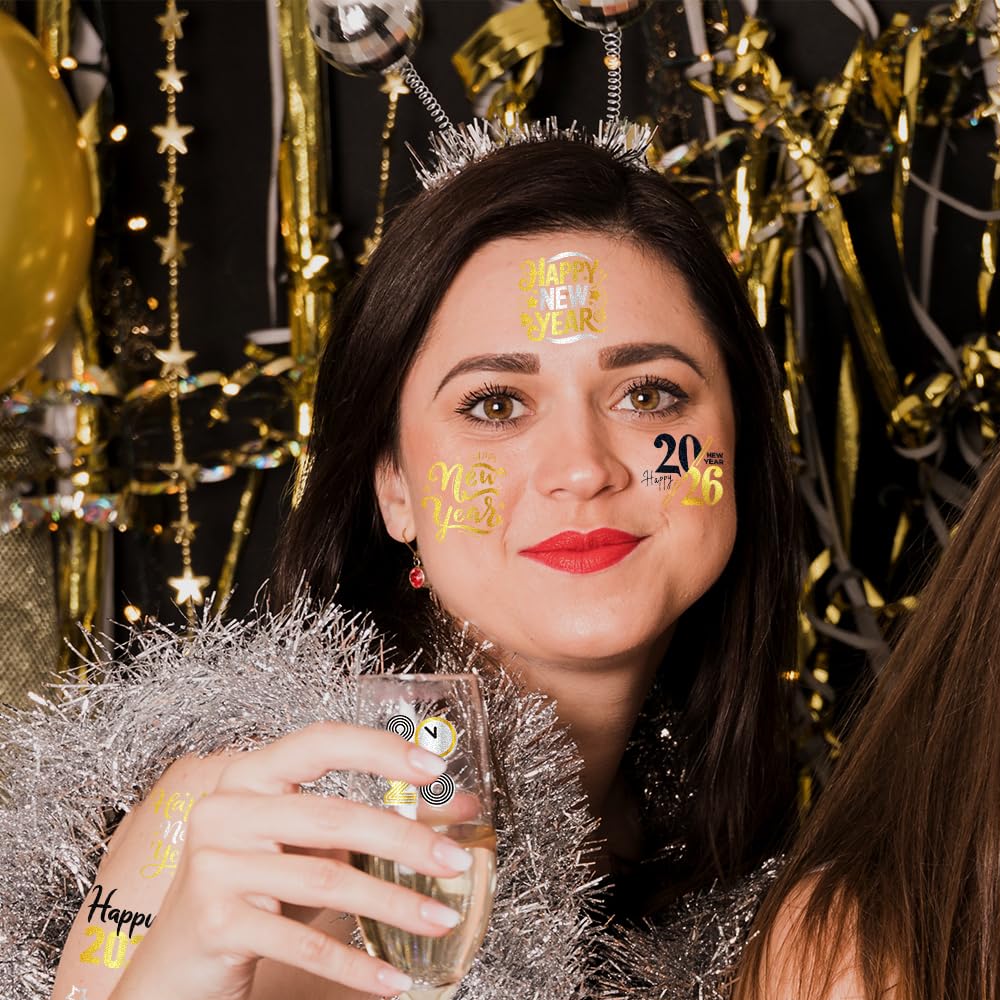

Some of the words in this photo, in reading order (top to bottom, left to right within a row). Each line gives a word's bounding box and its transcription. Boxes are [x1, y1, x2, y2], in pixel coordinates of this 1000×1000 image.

[518, 257, 600, 292] HAPPY
[540, 284, 589, 311] NEW
[527, 307, 606, 342] YEAR
[654, 433, 702, 477] 20
[427, 460, 508, 504] New
[641, 469, 674, 491] Happy
[680, 465, 724, 507] 26
[421, 495, 504, 543] Year
